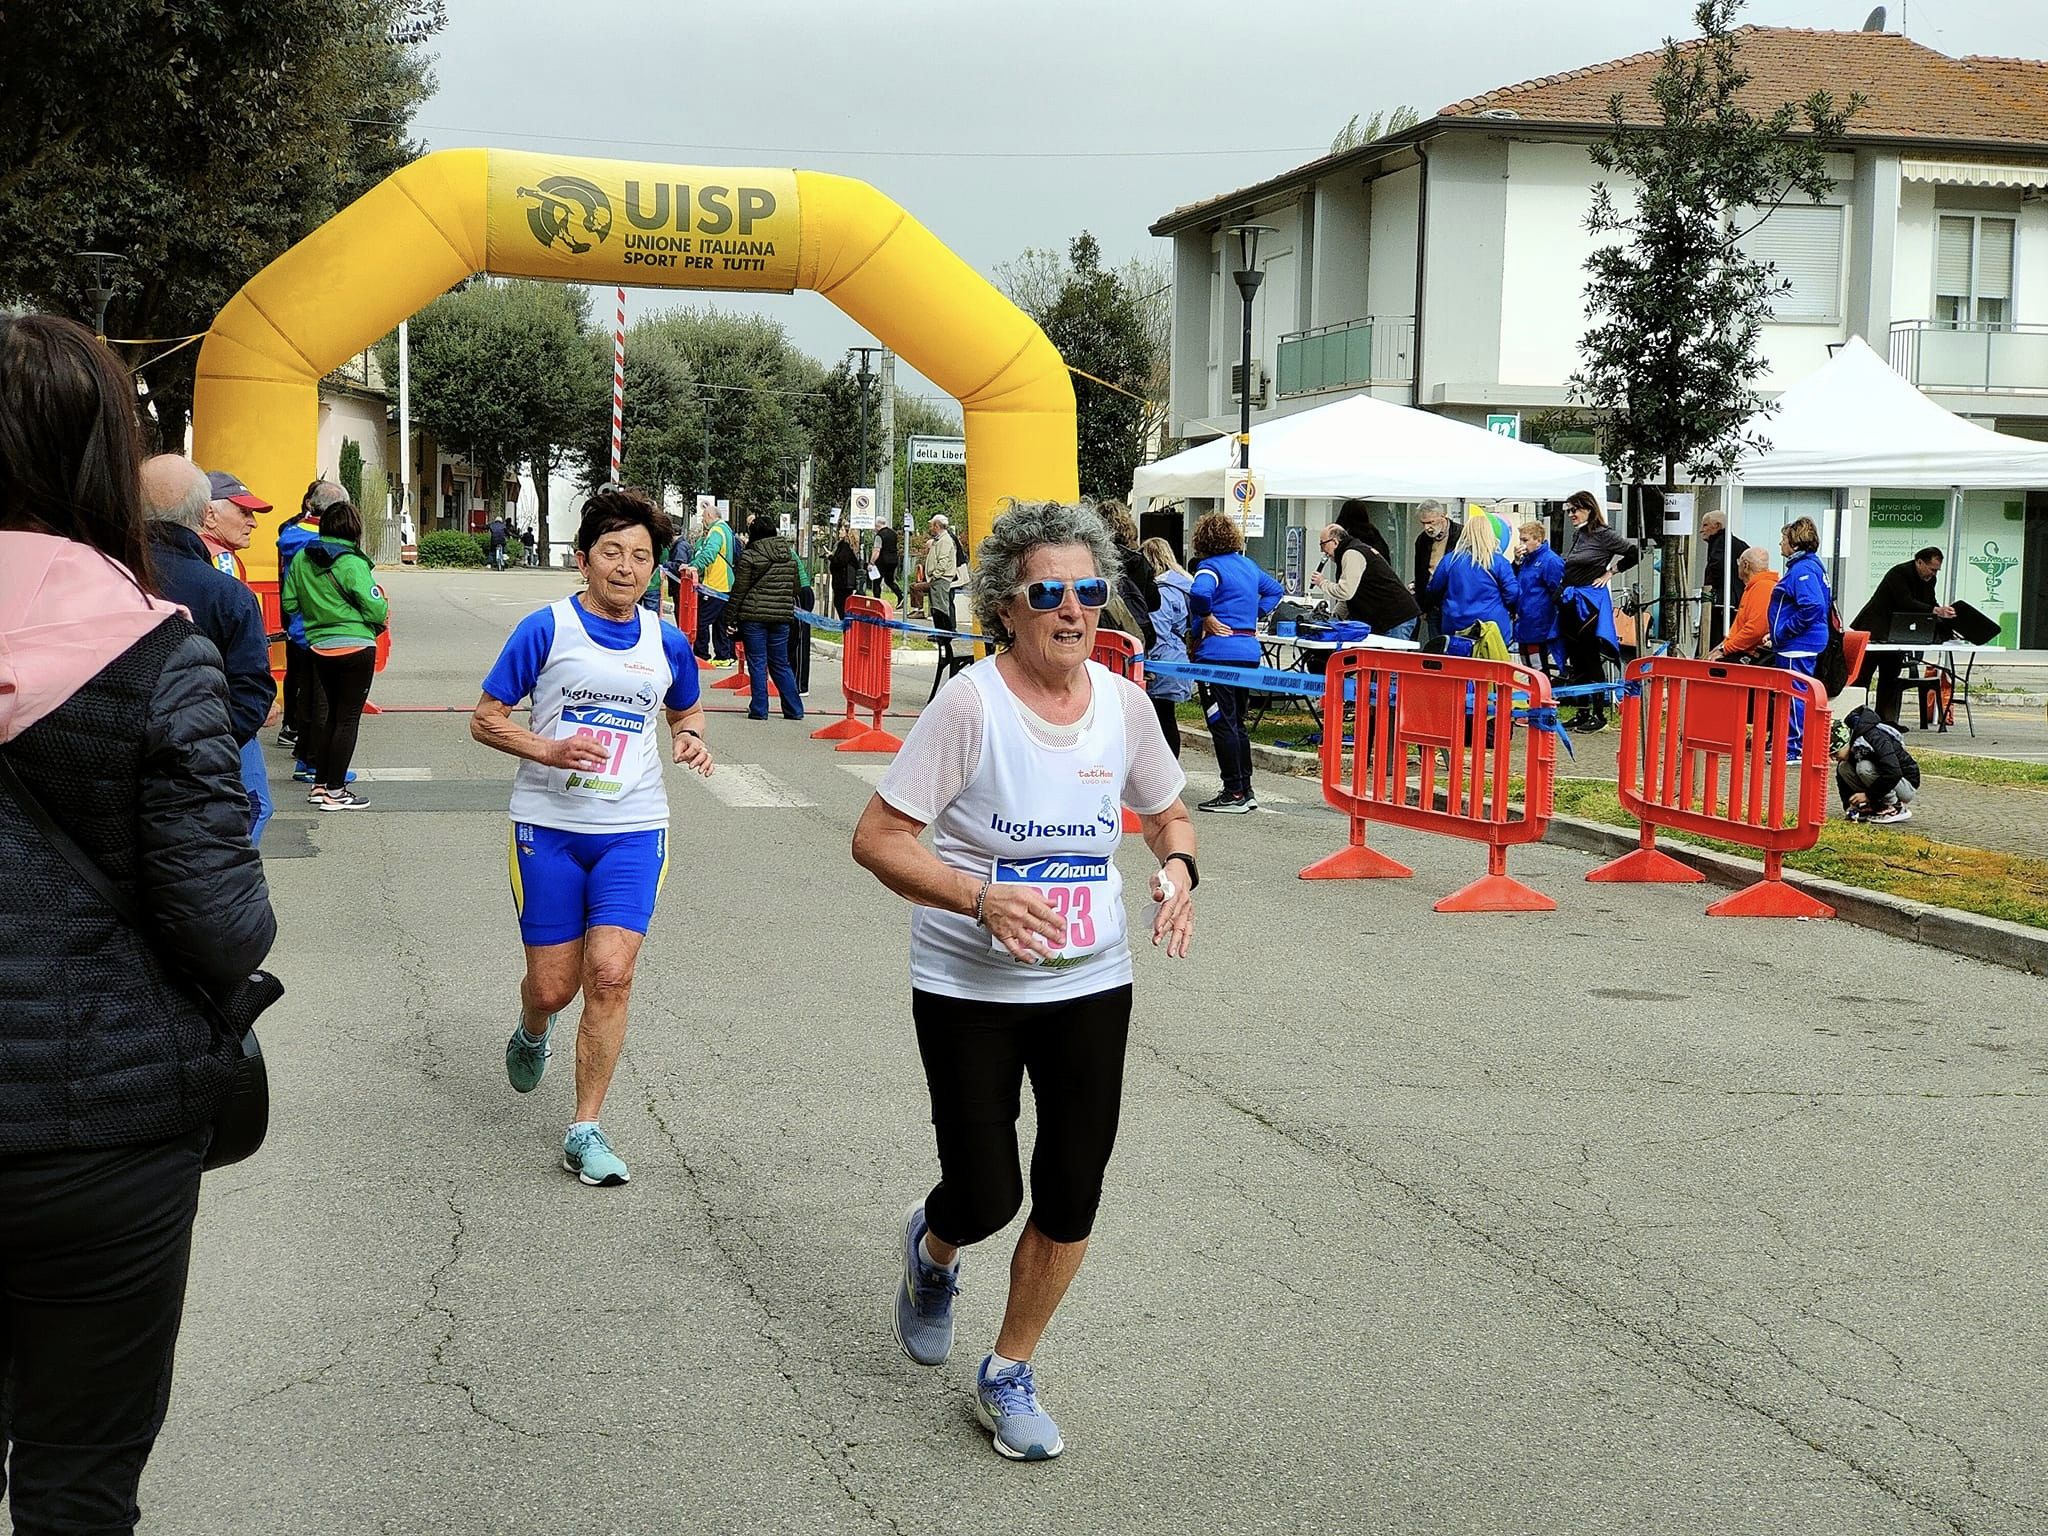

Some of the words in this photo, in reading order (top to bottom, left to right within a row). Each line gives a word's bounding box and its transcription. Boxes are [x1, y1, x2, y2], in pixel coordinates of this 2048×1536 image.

[624, 180, 777, 236] UISP
[624, 233, 691, 253] UNIONE
[699, 238, 776, 257] ITALIANA
[623, 251, 678, 269] SPORT
[684, 255, 713, 270] PER
[722, 258, 765, 272] TUTTI
[916, 449, 938, 459] della
[1871, 511, 1923, 522] Farmacia
[1876, 503, 1900, 511] servizi
[1902, 503, 1921, 511] della
[576, 727, 629, 776] 67
[990, 813, 1096, 842] lughesina
[1022, 886, 1096, 950] 33
